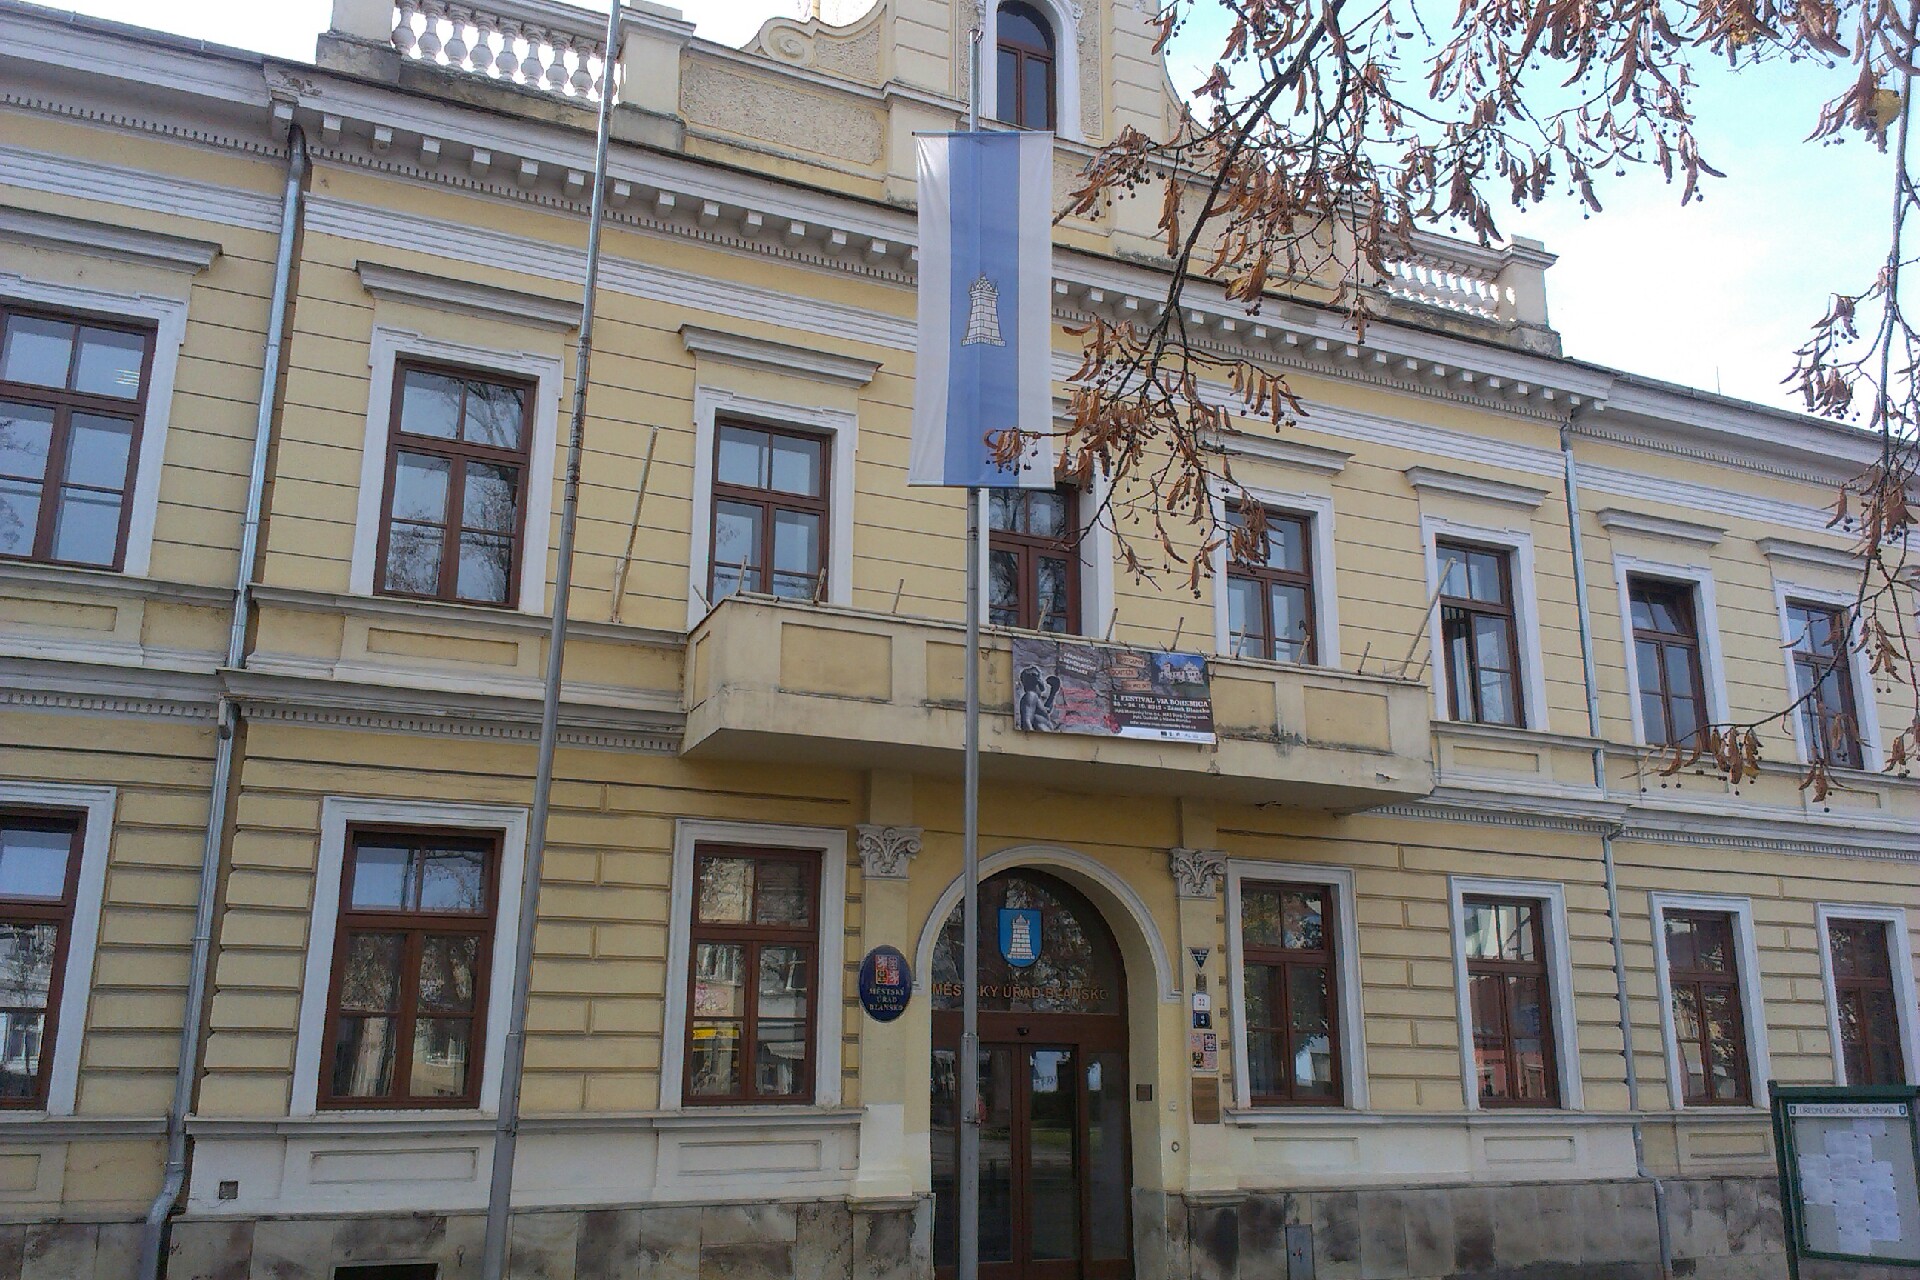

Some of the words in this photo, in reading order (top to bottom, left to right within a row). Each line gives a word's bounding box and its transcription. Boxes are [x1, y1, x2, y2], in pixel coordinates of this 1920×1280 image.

[1120, 695, 1155, 703] FESTIVAL
[1156, 697, 1169, 705] VIA
[1169, 698, 1209, 708] BOHEMICA
